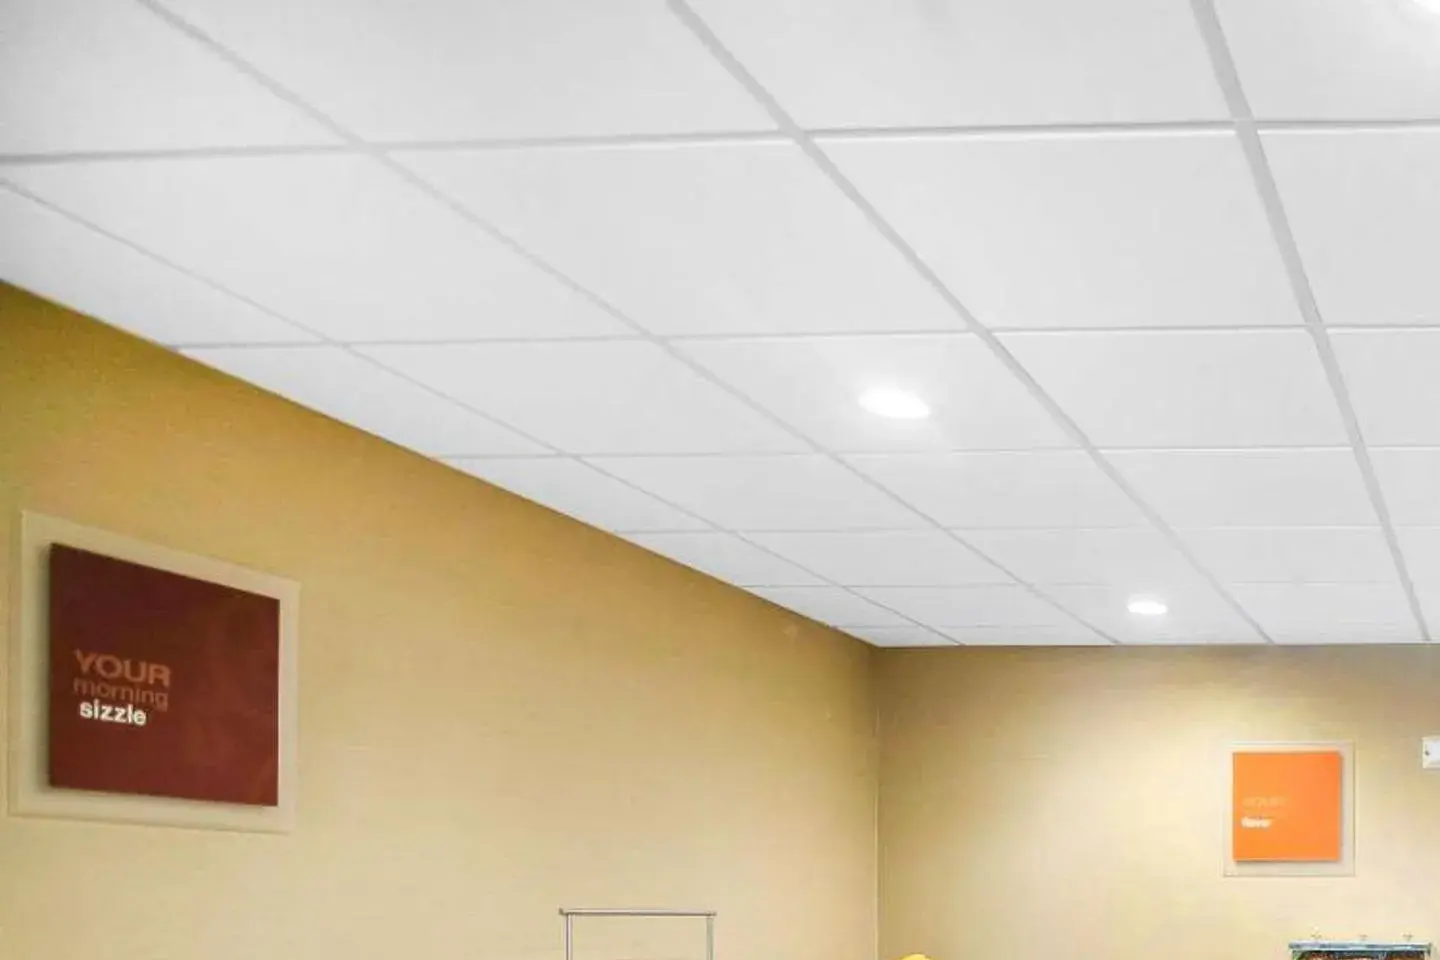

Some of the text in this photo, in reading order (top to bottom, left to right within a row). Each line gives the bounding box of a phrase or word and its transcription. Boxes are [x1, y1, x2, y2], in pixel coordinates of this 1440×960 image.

[74, 648, 170, 687] YOUR
[73, 678, 168, 712] morning
[80, 698, 146, 725] sizzle
